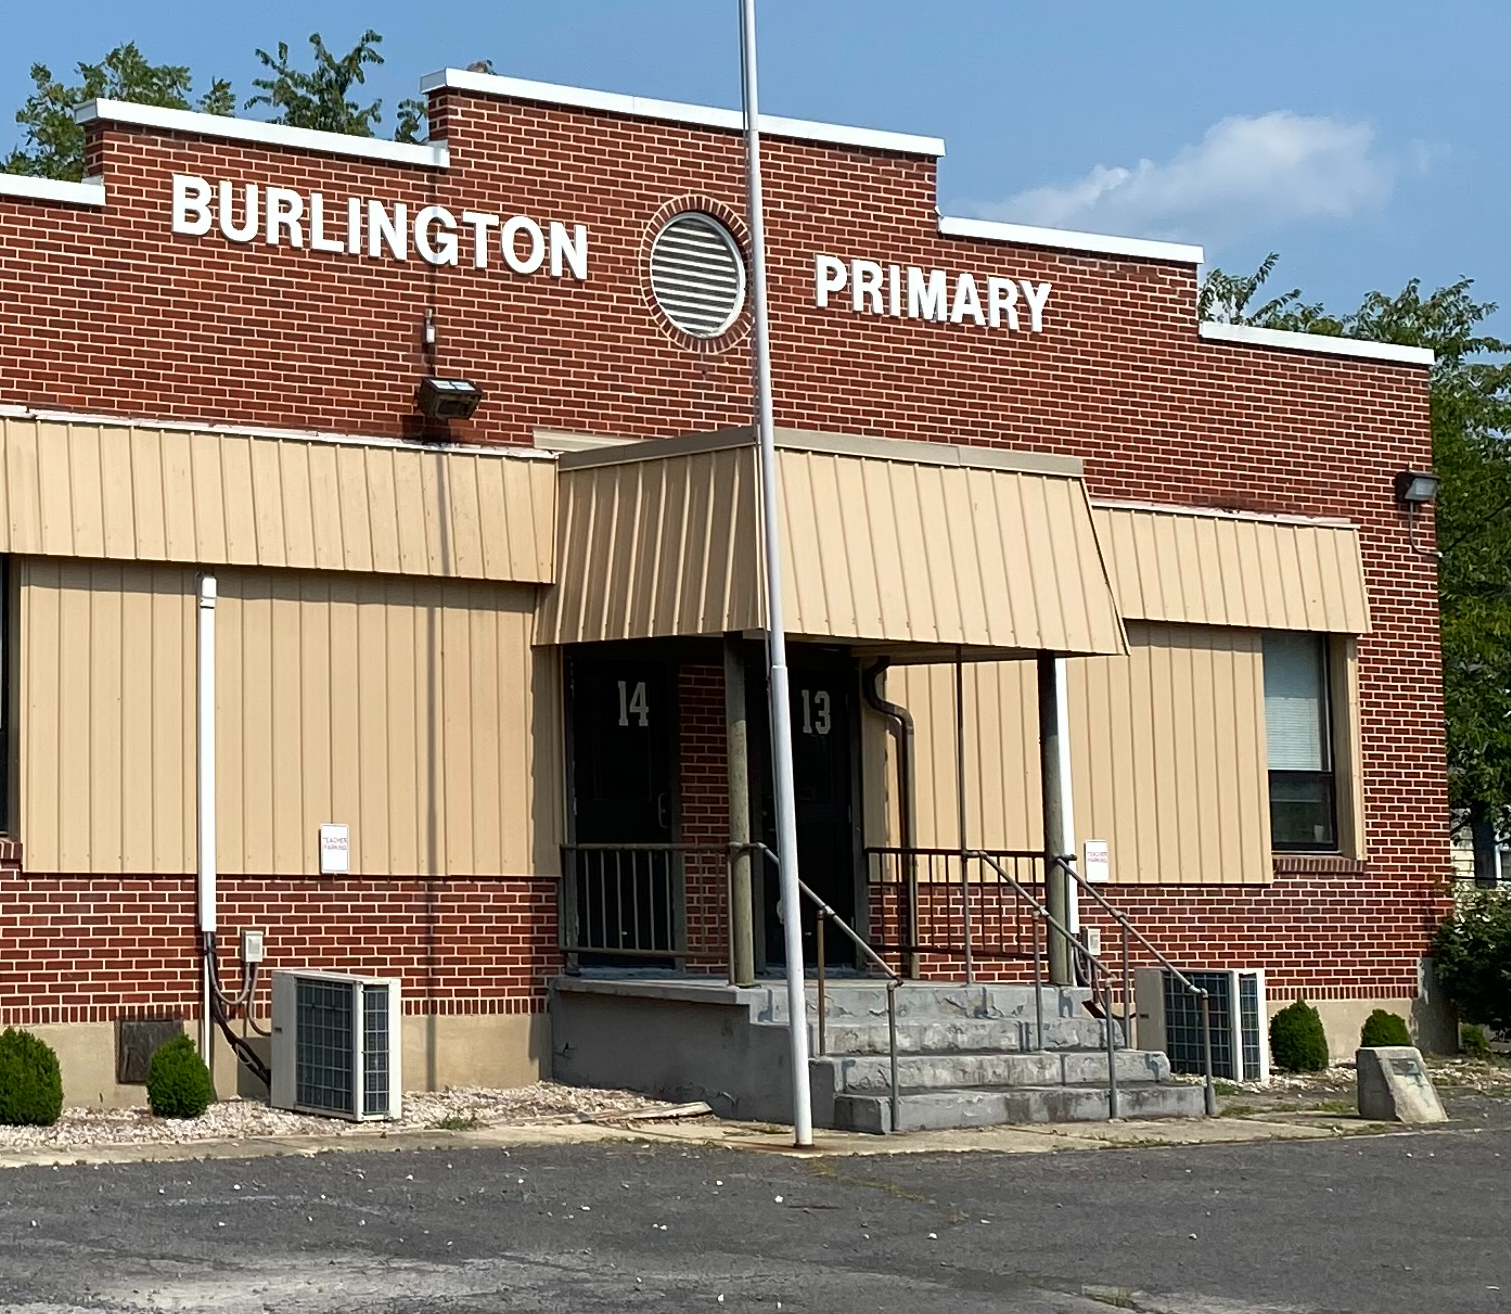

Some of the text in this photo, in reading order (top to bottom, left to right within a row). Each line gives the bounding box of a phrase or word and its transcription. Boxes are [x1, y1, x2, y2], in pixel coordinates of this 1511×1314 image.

[171, 172, 1053, 333] BURLINGTON PRIMARY
[618, 680, 650, 727] 14
[801, 689, 831, 735] 13
